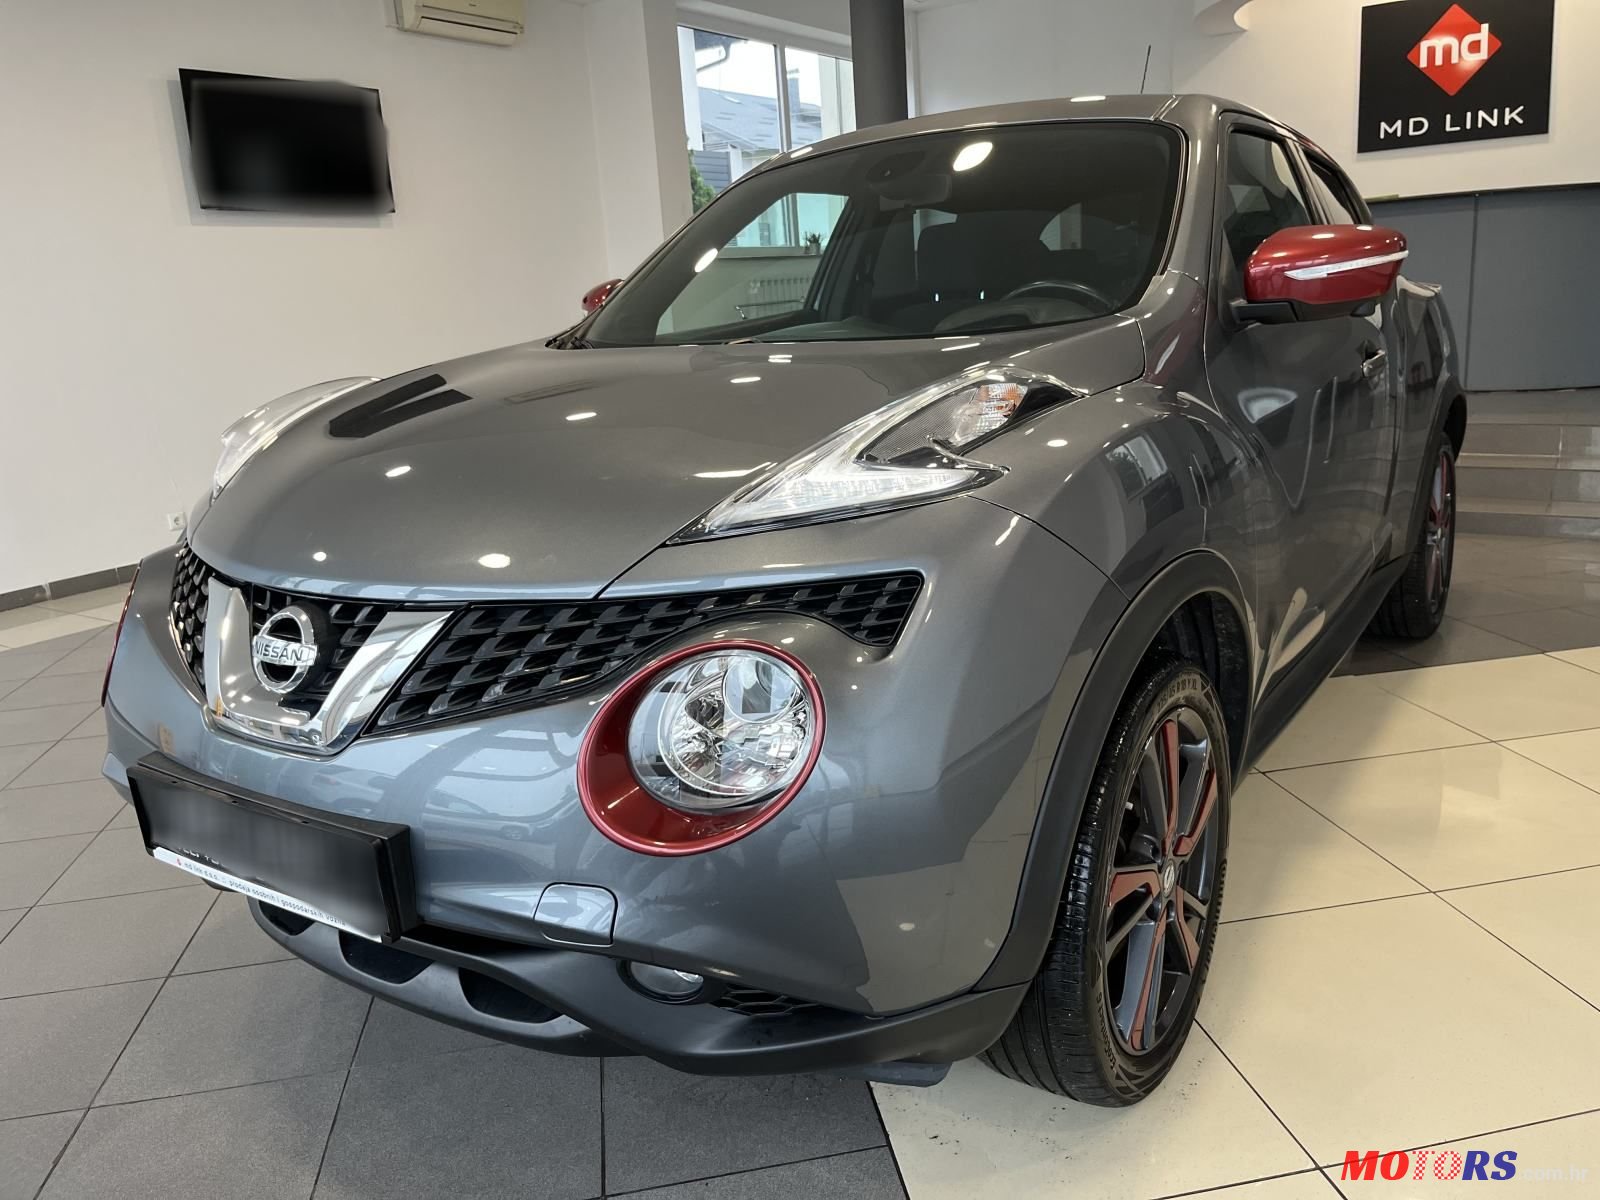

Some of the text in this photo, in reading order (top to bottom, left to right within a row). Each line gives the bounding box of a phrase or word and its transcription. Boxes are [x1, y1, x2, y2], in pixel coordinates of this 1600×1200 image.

[1419, 23, 1489, 68] md
[1379, 106, 1524, 139] MD LINK
[255, 641, 303, 661] NISSAN
